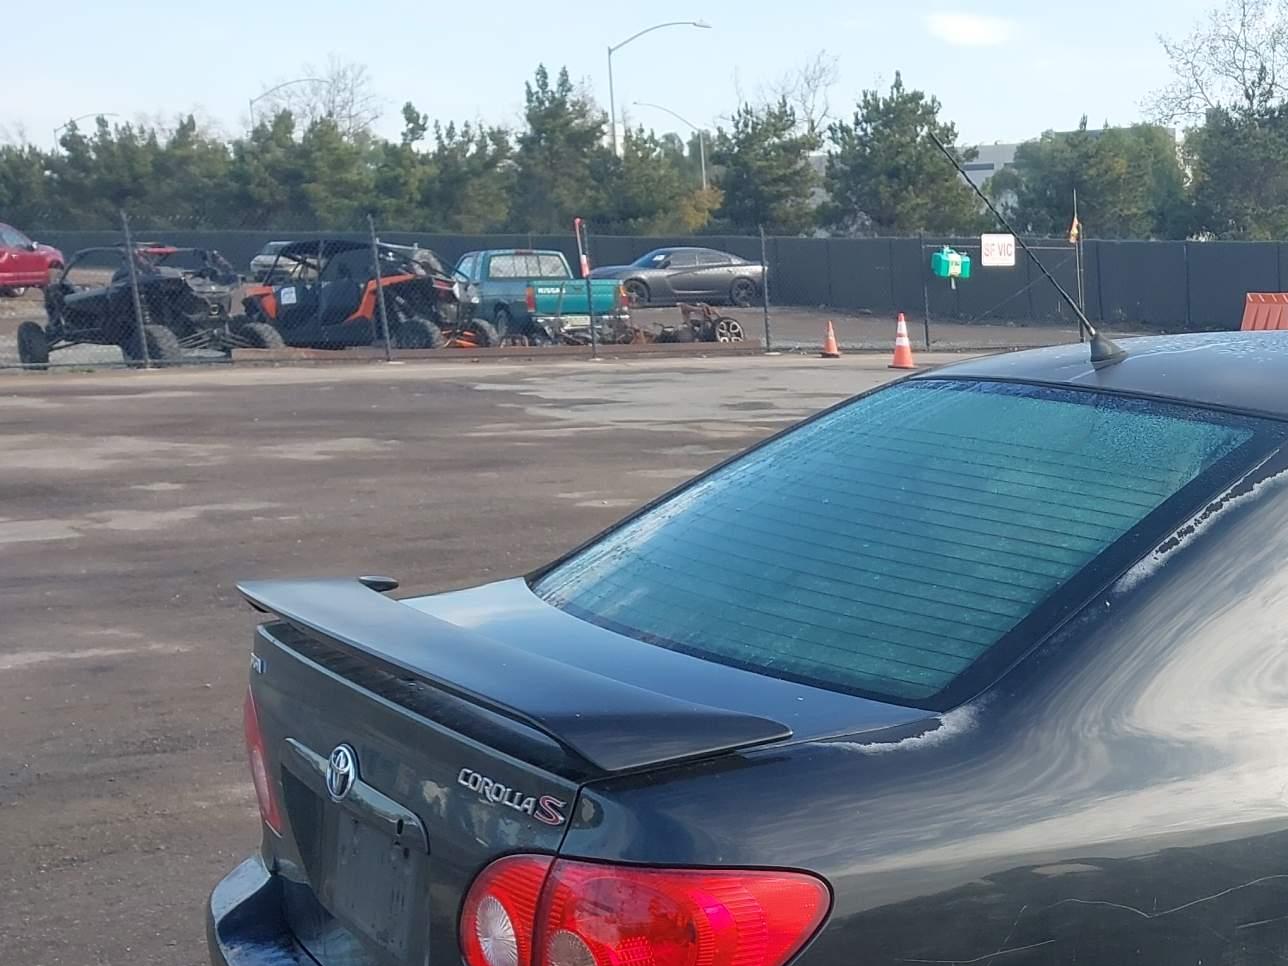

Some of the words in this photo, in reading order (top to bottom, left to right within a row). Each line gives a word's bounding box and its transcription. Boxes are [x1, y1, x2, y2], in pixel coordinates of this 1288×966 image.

[997, 242, 1013, 257] VIC
[458, 768, 537, 815] COROLLA
[533, 795, 567, 826] S
